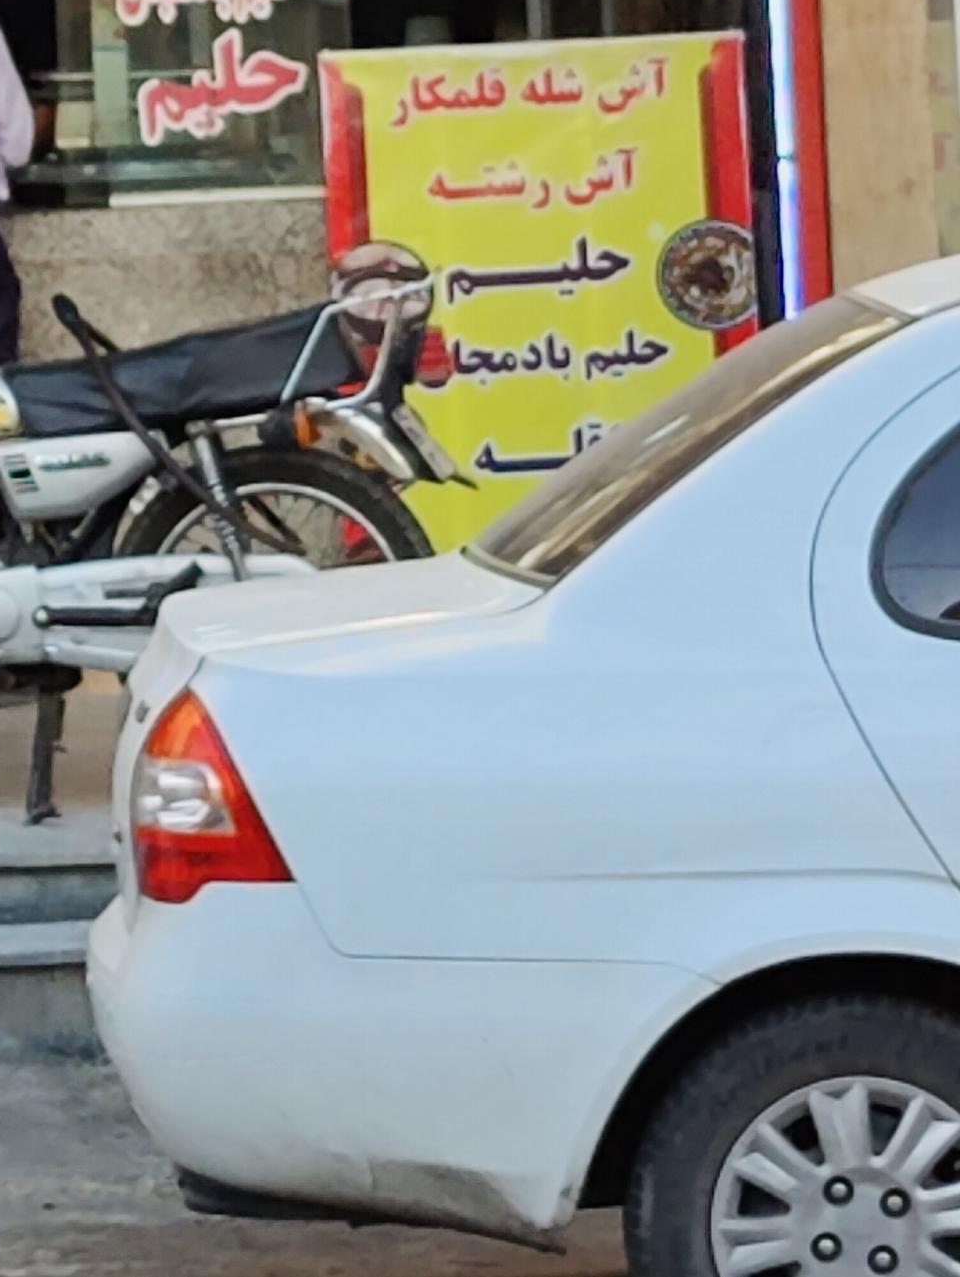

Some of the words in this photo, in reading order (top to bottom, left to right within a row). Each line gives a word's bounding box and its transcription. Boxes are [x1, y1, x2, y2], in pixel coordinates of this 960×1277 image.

[139, 29, 307, 144] حلیم
[389, 66, 507, 128] قلمکار
[520, 68, 584, 105] شله
[597, 57, 669, 114] آش
[427, 160, 551, 210] رشته
[565, 147, 639, 206] آش
[446, 237, 631, 303] حلیم
[452, 332, 572, 386] بادمجا
[584, 329, 669, 380] حلیم
